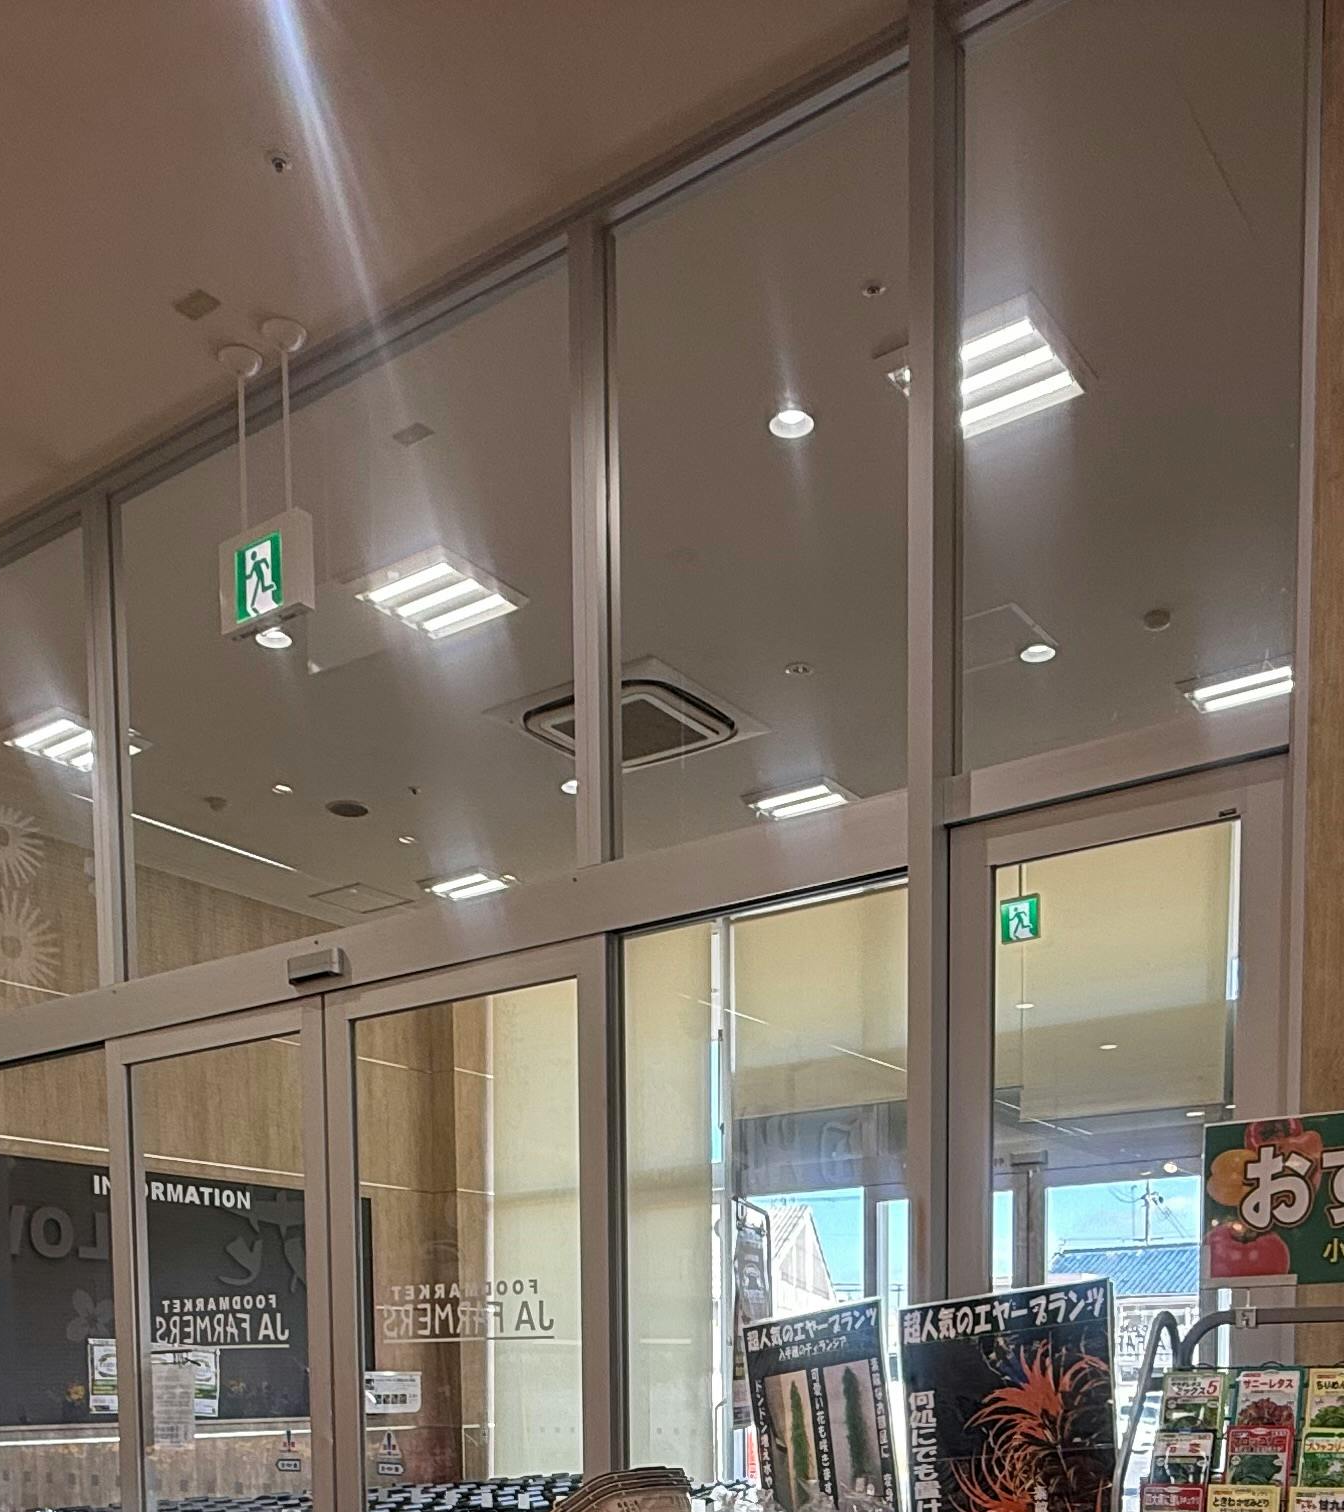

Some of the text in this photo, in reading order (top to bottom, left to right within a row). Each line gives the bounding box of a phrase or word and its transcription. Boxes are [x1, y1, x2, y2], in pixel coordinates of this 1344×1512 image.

[93, 1175, 251, 1210] INRMATION
[747, 1307, 877, 1352] 超人気のエヤープランツ
[903, 1286, 1105, 1345] 超人気のエヤープランツ
[1243, 1379, 1294, 1389] サニーレタス
